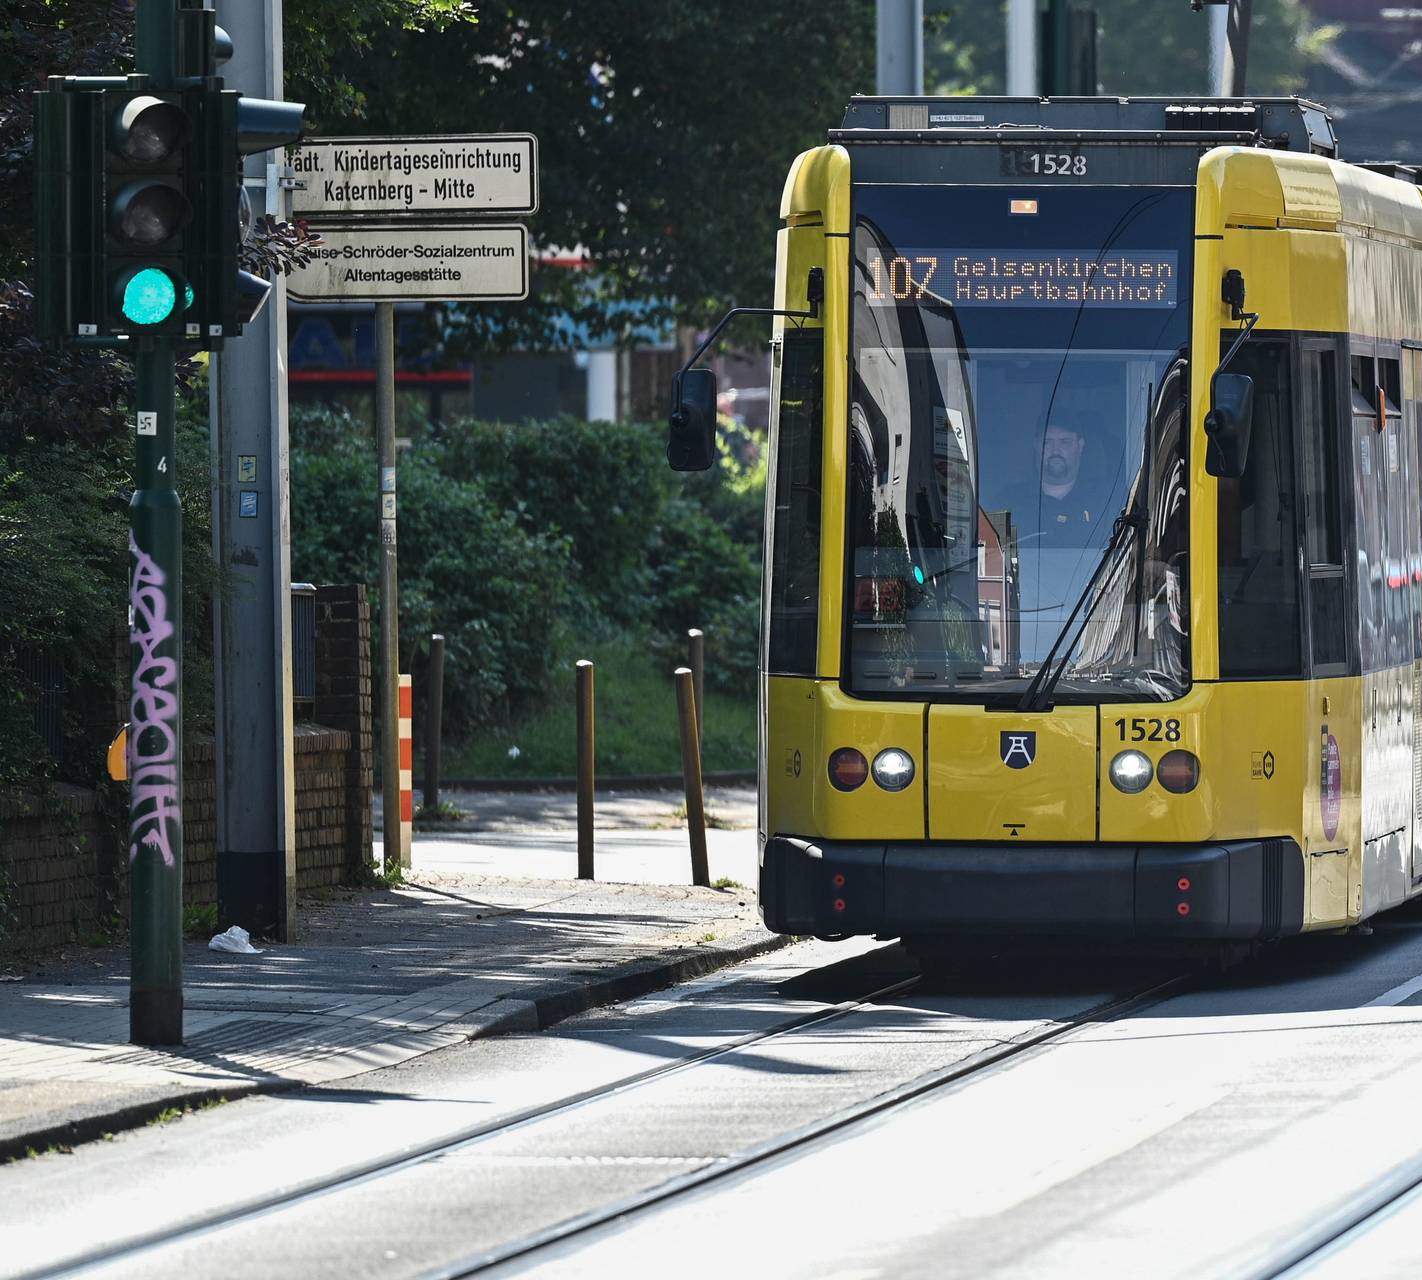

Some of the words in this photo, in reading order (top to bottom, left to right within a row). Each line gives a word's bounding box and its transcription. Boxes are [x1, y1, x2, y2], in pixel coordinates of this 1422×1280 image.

[284, 150, 324, 172] tädt.
[334, 149, 521, 175] Kindertageseinrichtung
[1030, 153, 1087, 176] 1528
[325, 180, 413, 205] Katernberg
[434, 178, 475, 199] Mitte
[343, 267, 462, 283] Altentagesstätte
[868, 256, 937, 300] 107
[953, 256, 1173, 277] Gelsenkirchen
[956, 280, 1167, 301] Hauptbahnhof
[1114, 718, 1181, 742] 1528
